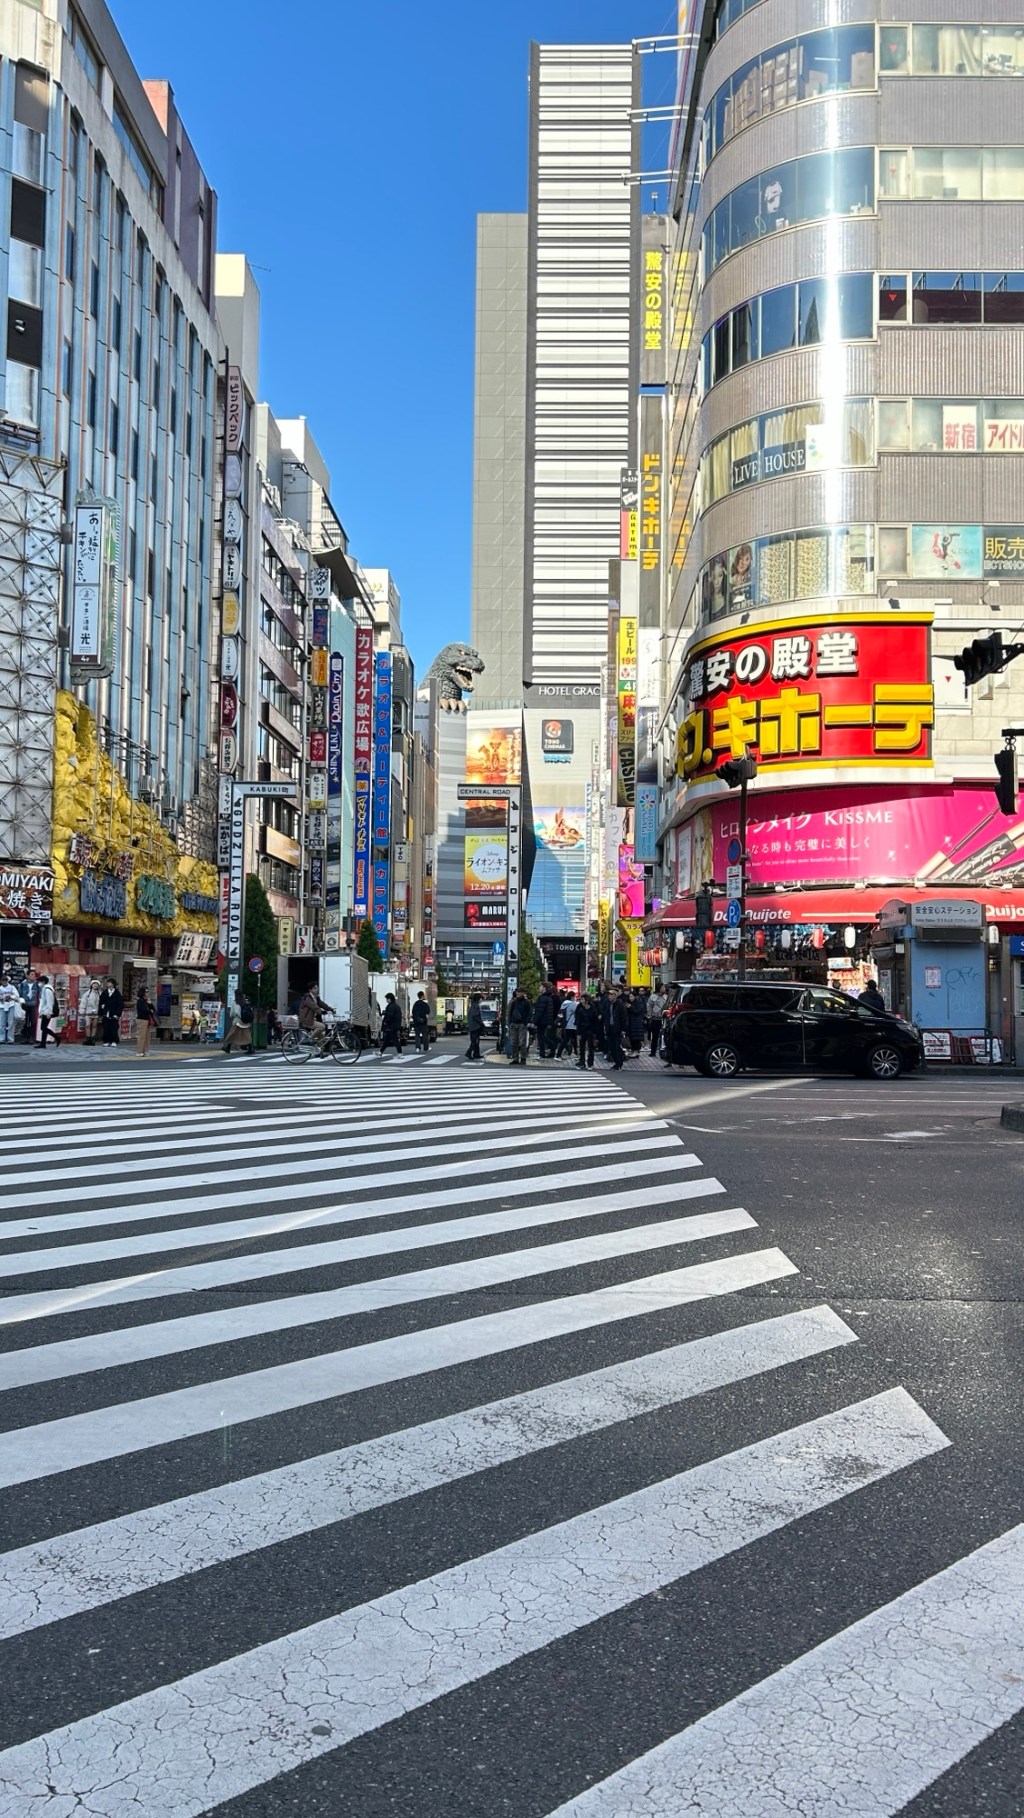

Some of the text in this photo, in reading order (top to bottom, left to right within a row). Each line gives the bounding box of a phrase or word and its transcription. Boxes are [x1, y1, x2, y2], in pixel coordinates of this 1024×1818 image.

[645, 252, 662, 349] 驚安の殿堂
[945, 423, 975, 449] 新宿
[734, 449, 805, 485] LIVE HOUSE
[985, 537, 1024, 559] 販売
[80, 633, 91, 645] 光
[626, 621, 635, 655] 生ビール
[690, 631, 858, 700] 驚安の殿堂
[356, 633, 370, 751] カラオケ歌広場
[539, 686, 571, 695] HOTEL
[746, 836, 870, 854] なる時も完璧に美しく
[0, 873, 54, 891] MIYAKI
[230, 811, 242, 943] GODZILLA ROAD
[510, 825, 519, 936] ゴジラロード
[7, 890, 43, 909] 焼き
[915, 907, 977, 915] 安全安心ステーション
[714, 911, 728, 921] Do
